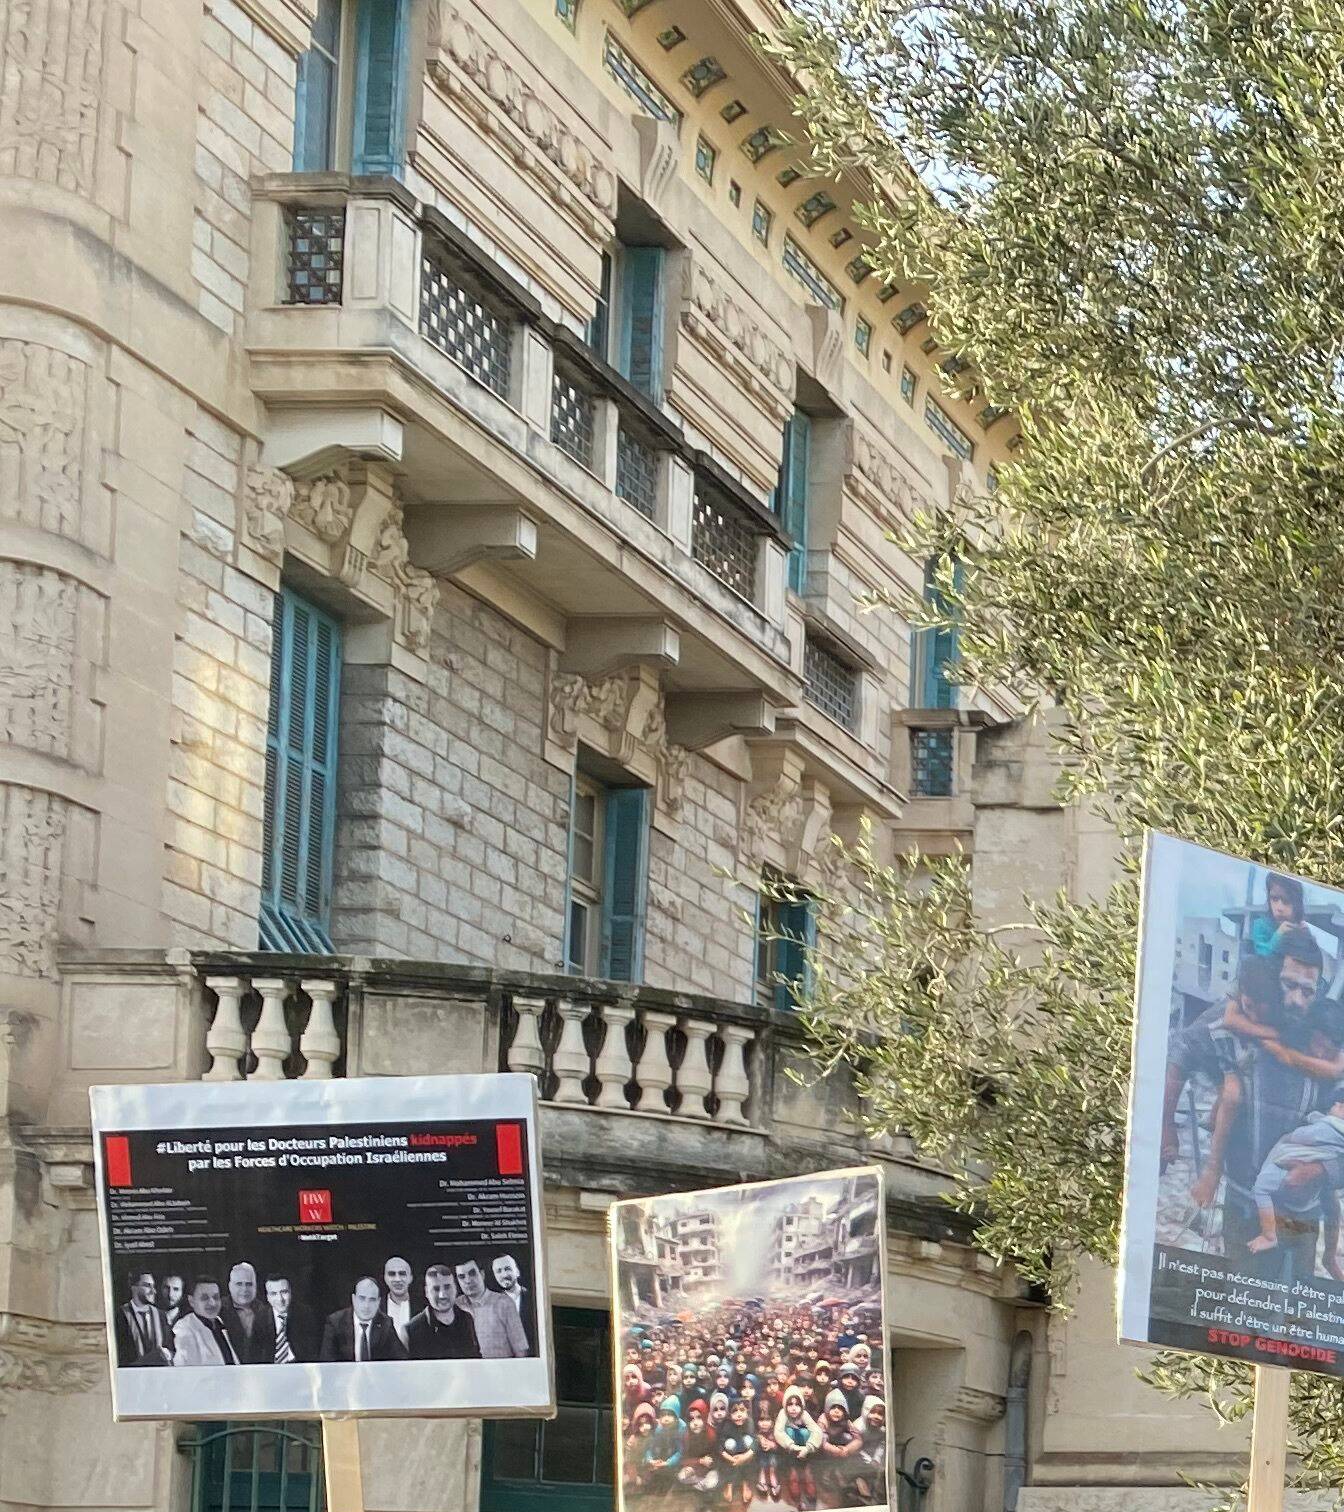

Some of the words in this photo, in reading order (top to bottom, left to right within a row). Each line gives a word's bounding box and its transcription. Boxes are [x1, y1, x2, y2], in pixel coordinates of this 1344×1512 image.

[157, 1140, 212, 1154] #Liberté
[215, 1143, 245, 1155] pour
[248, 1139, 266, 1150] les
[269, 1138, 326, 1150] Docteurs
[329, 1135, 408, 1148] Palestiniens
[410, 1133, 477, 1147] kidnappés
[188, 1159, 209, 1172] par
[213, 1156, 231, 1168] les
[235, 1156, 276, 1167] Forces
[279, 1153, 362, 1168] d'Occupation
[366, 1151, 447, 1163] Israéliennes
[1159, 1251, 1167, 1270] Il
[1169, 1260, 1199, 1274] n'est
[1201, 1268, 1224, 1282] pas
[1227, 1272, 1289, 1293] nécessaire
[1291, 1281, 1326, 1300] d'être
[1196, 1288, 1227, 1305] pour
[1228, 1289, 1281, 1312] défendre
[1284, 1299, 1294, 1314] la
[1190, 1304, 1197, 1317] il
[1200, 1306, 1233, 1323] suffit
[1235, 1311, 1270, 1331] d'être
[1272, 1324, 1287, 1334] un
[1289, 1324, 1313, 1339] être
[1208, 1328, 1250, 1347] STOP
[1255, 1337, 1336, 1363] GENOCIDE
